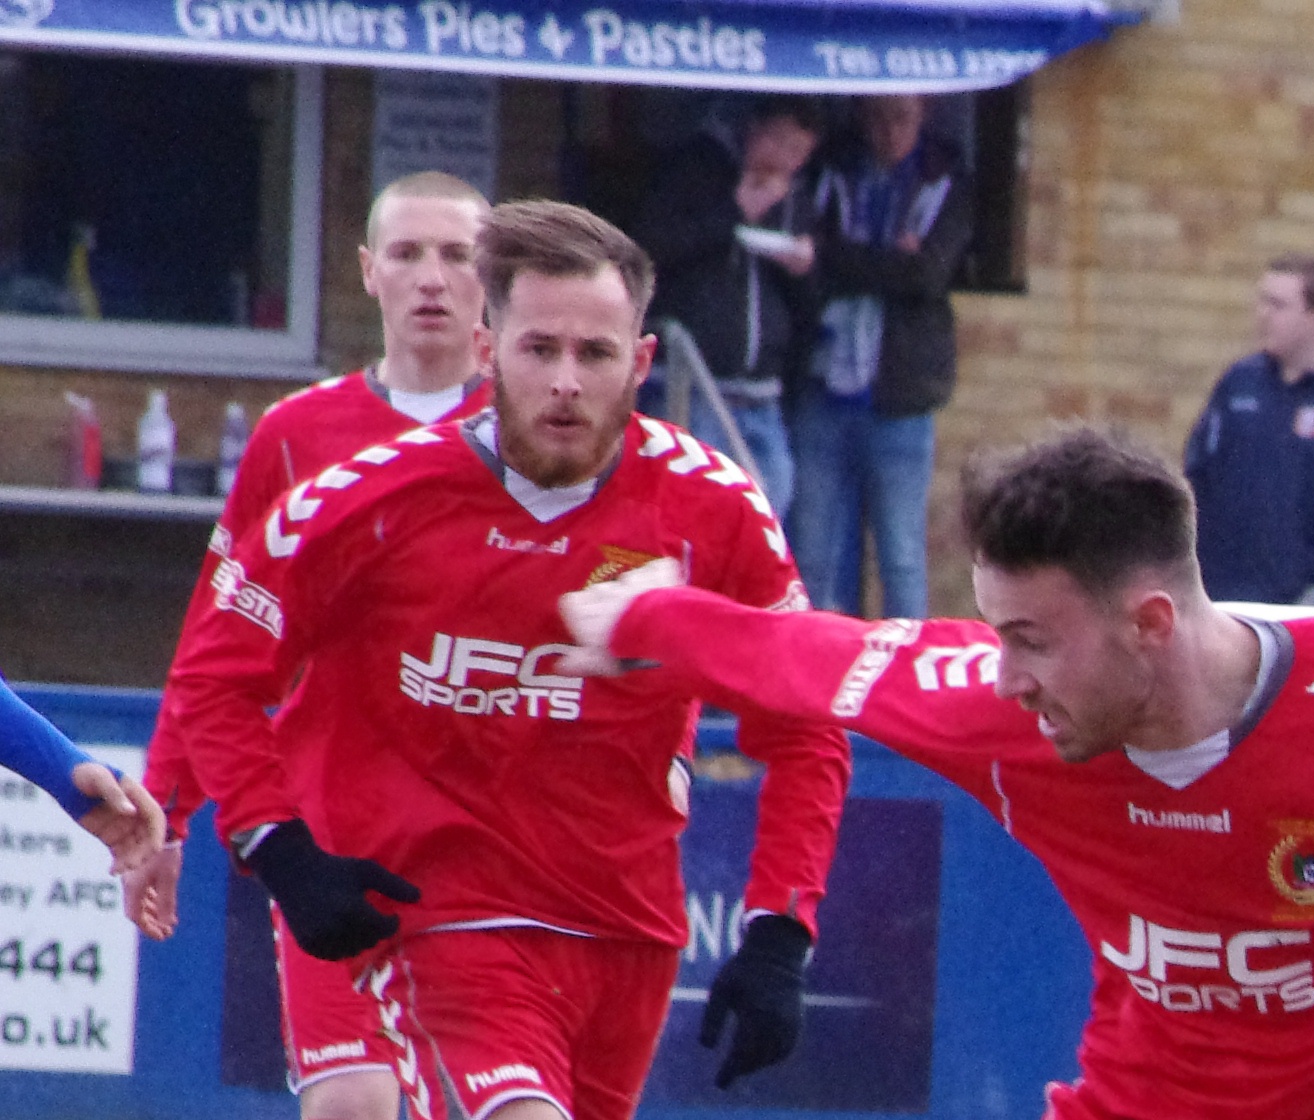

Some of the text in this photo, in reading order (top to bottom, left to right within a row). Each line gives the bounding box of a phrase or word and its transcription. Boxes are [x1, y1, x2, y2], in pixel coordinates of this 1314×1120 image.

[176, 0, 407, 49] Growlers
[419, 3, 526, 55] Pies
[583, 8, 767, 72] Pasties
[400, 631, 585, 689] JFC
[400, 666, 581, 722] SPORTS
[1126, 801, 1232, 834] hummel
[1101, 913, 1312, 987] JFC
[302, 1040, 367, 1065] hummel
